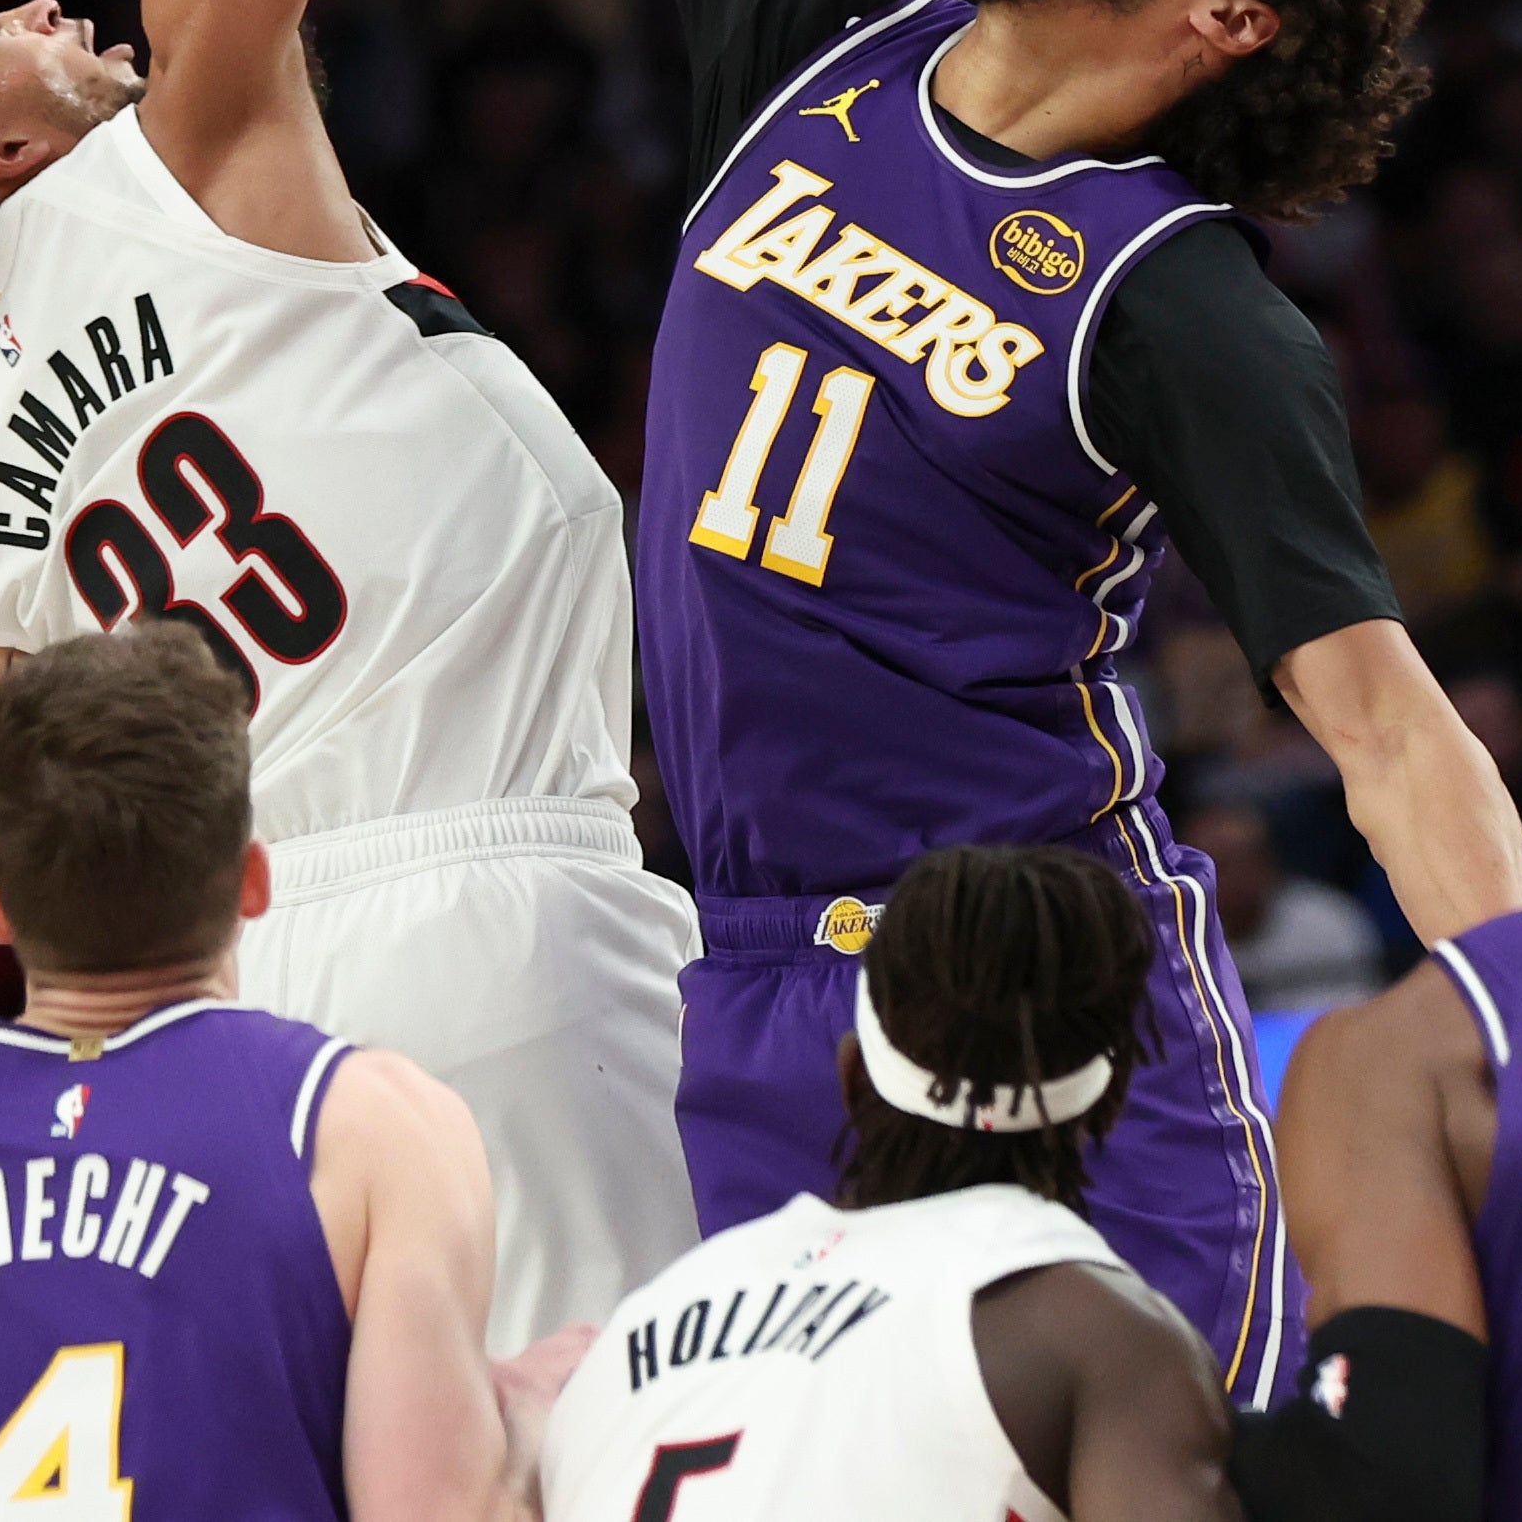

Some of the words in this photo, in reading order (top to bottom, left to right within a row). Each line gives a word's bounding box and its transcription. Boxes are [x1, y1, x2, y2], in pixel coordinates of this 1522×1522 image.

[694, 159, 1045, 417] LAKERS
[1003, 220, 1076, 278] bibigo
[65, 411, 347, 719] 33
[688, 342, 875, 587] 11
